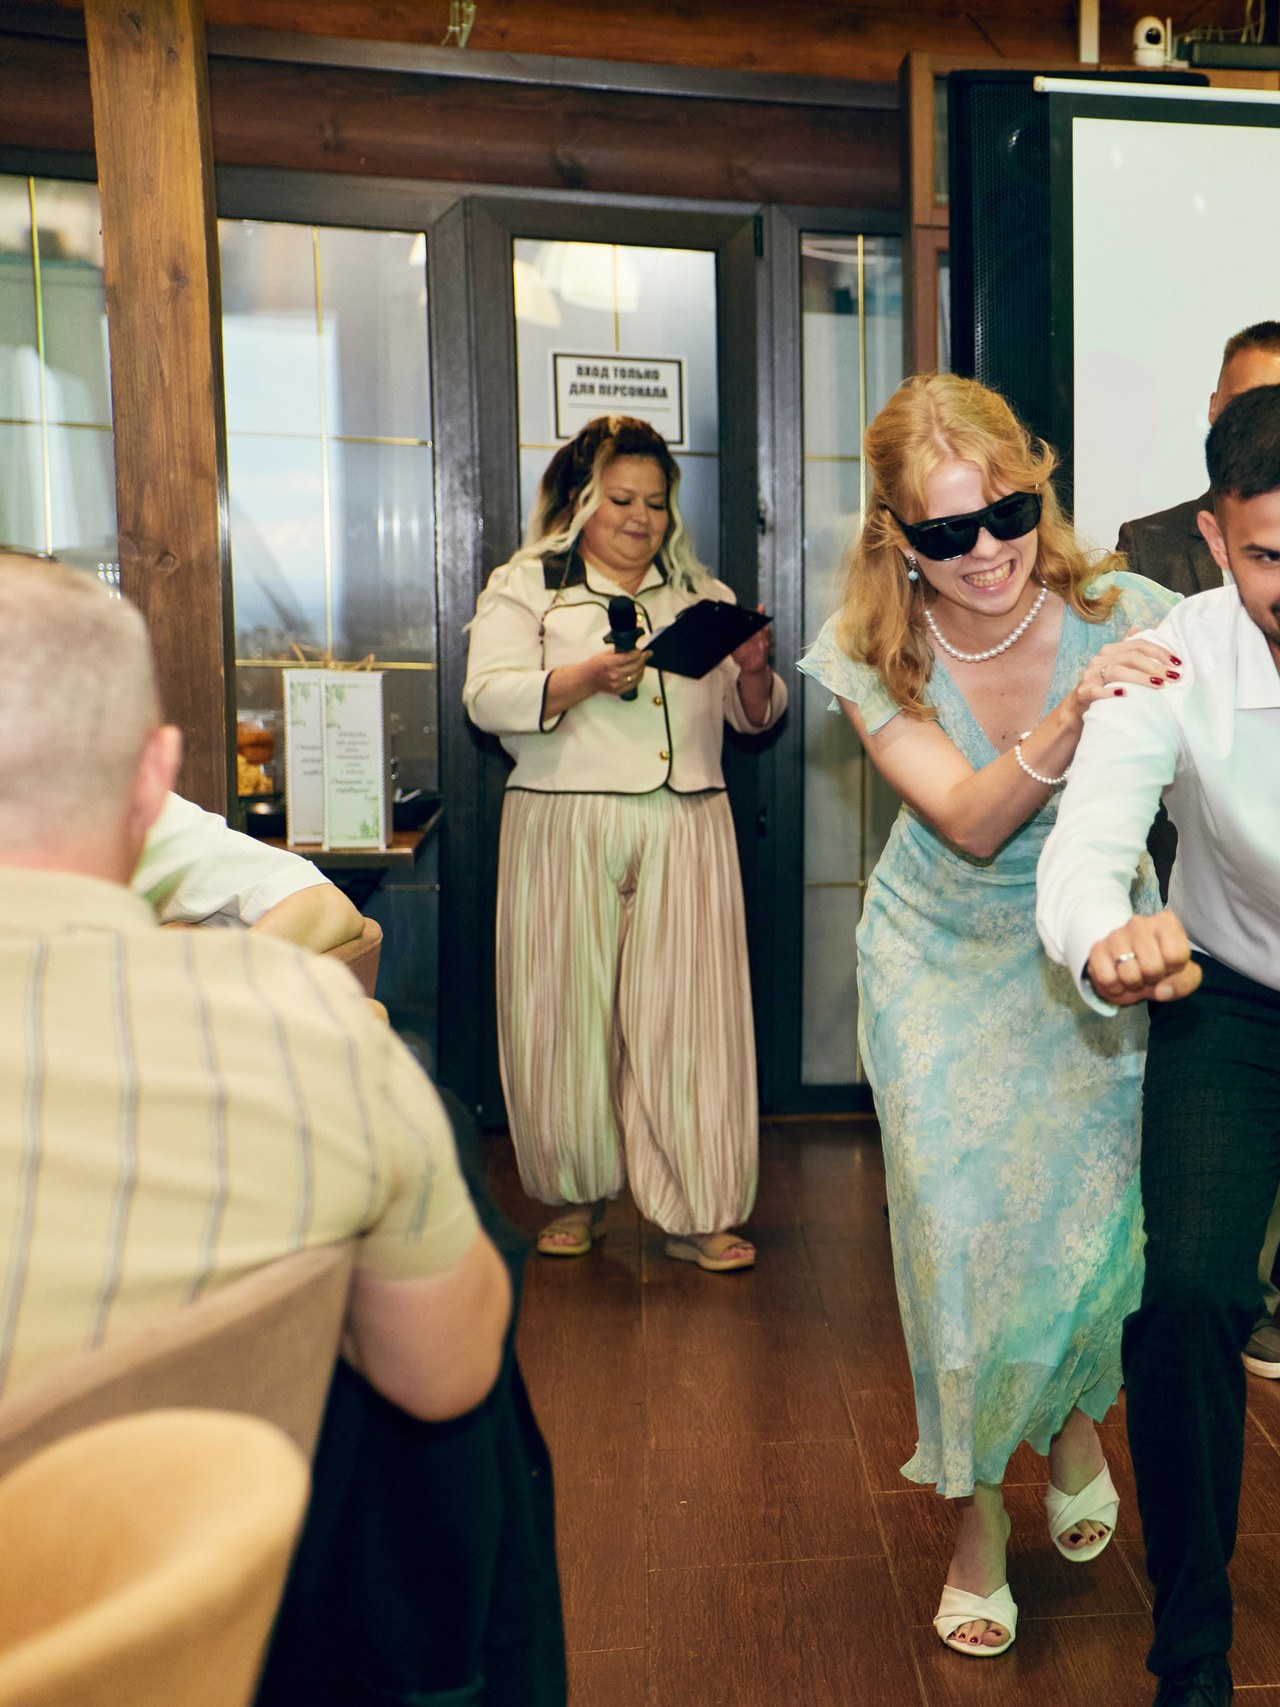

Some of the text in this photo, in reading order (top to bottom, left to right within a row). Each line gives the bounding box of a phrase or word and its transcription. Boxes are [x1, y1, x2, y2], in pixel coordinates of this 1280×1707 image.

[576, 365, 660, 381] ВХОД ТОЛЬКО
[569, 382, 668, 399] ДЛЯ ПЕРСОНАЛА
